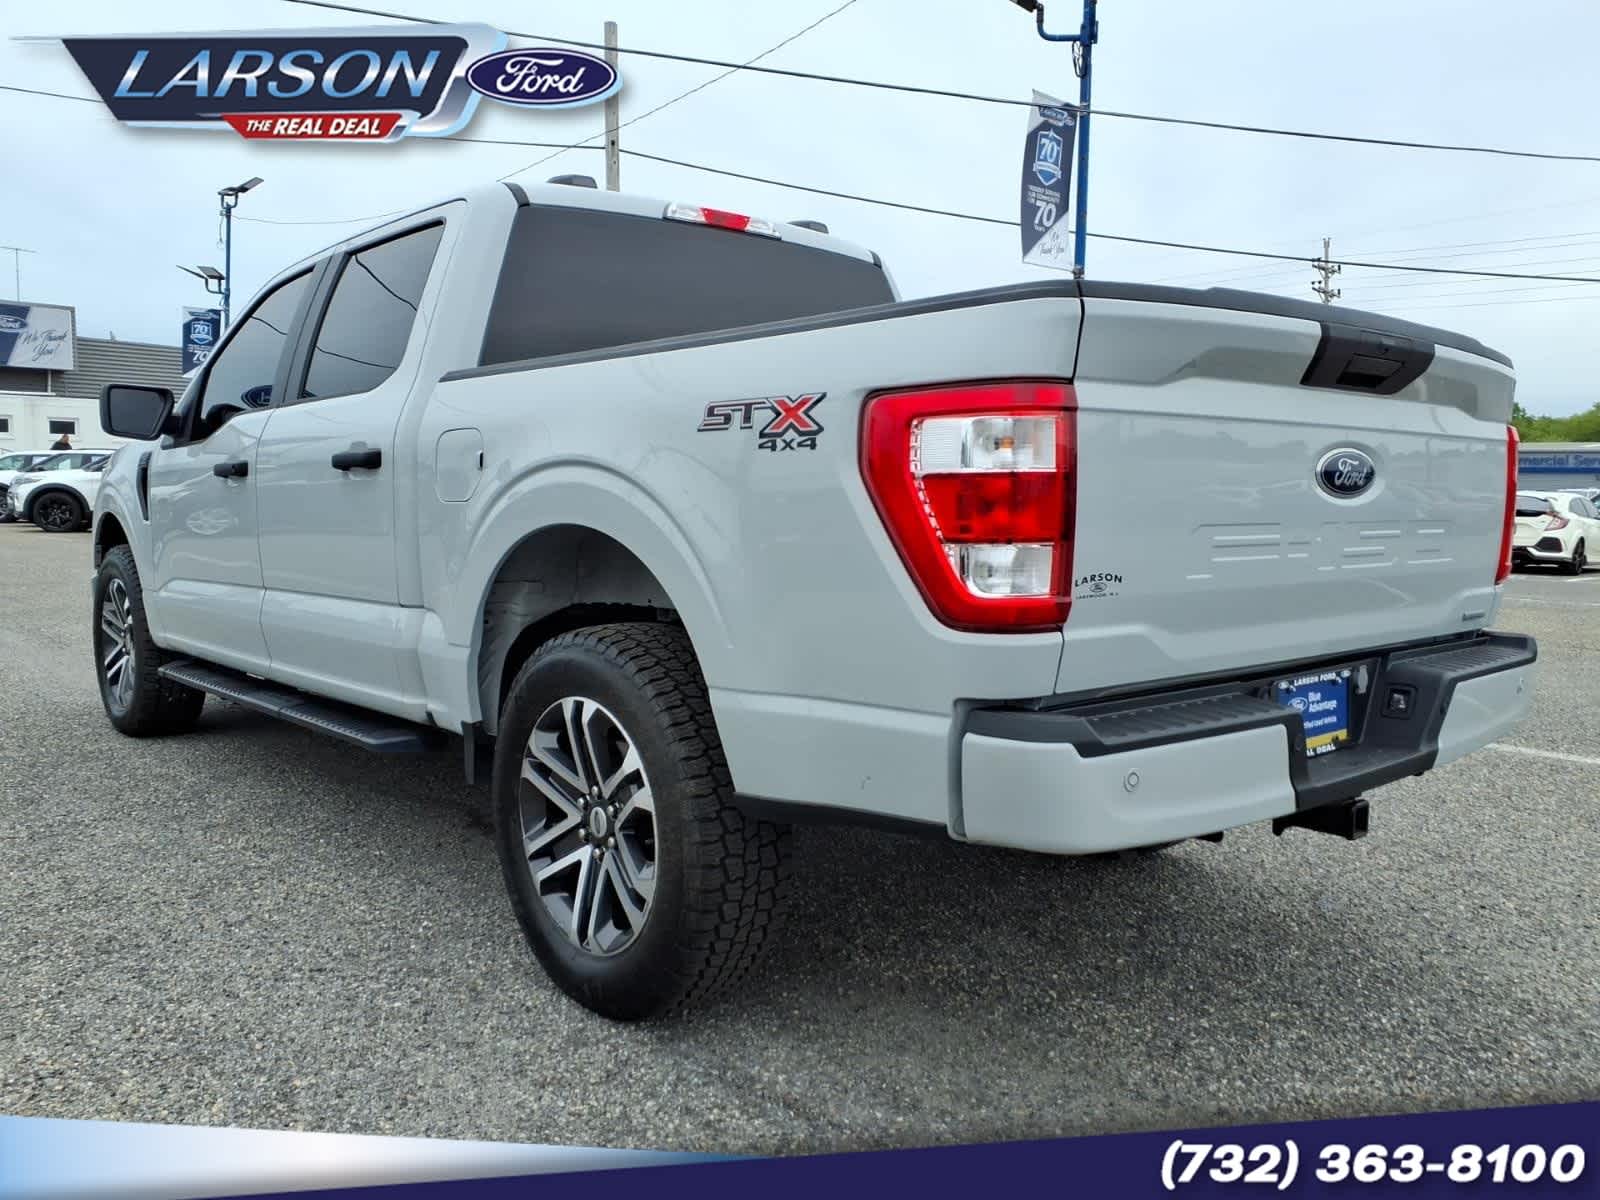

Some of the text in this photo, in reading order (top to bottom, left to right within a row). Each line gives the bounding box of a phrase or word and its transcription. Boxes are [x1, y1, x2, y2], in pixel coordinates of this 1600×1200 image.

[1039, 138, 1058, 163] 70
[1034, 200, 1057, 227] 70
[193, 324, 209, 335] 70
[697, 392, 827, 439] STX
[1334, 458, 1368, 486] Ford
[1074, 572, 1123, 587] LARSON
[1316, 743, 1336, 754] DEAL
